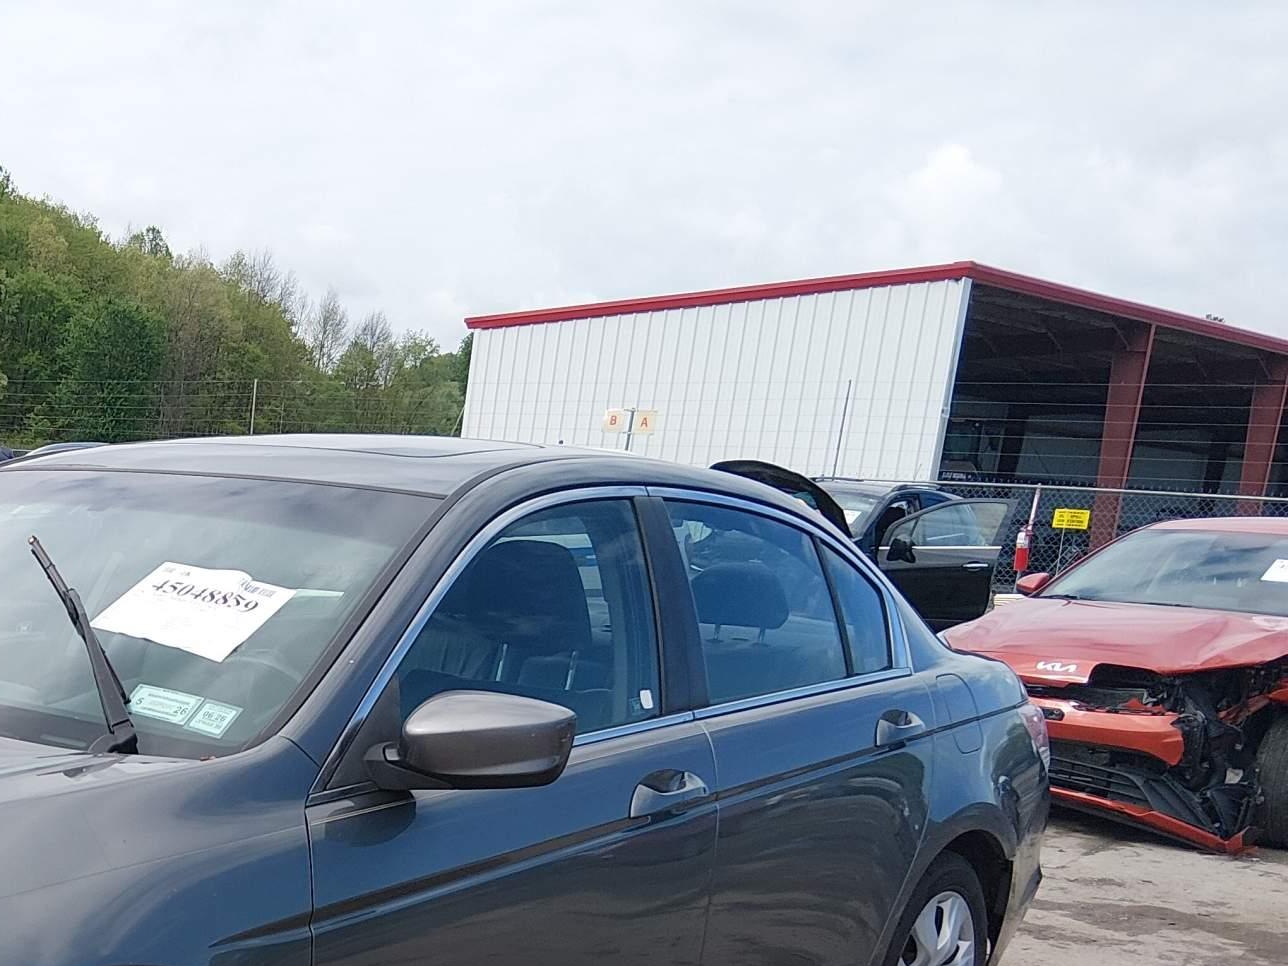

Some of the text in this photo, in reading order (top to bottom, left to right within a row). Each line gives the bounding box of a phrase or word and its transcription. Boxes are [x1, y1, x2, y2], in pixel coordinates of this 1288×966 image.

[609, 415, 617, 426] B
[640, 417, 648, 428] A
[151, 579, 260, 613] 45048859
